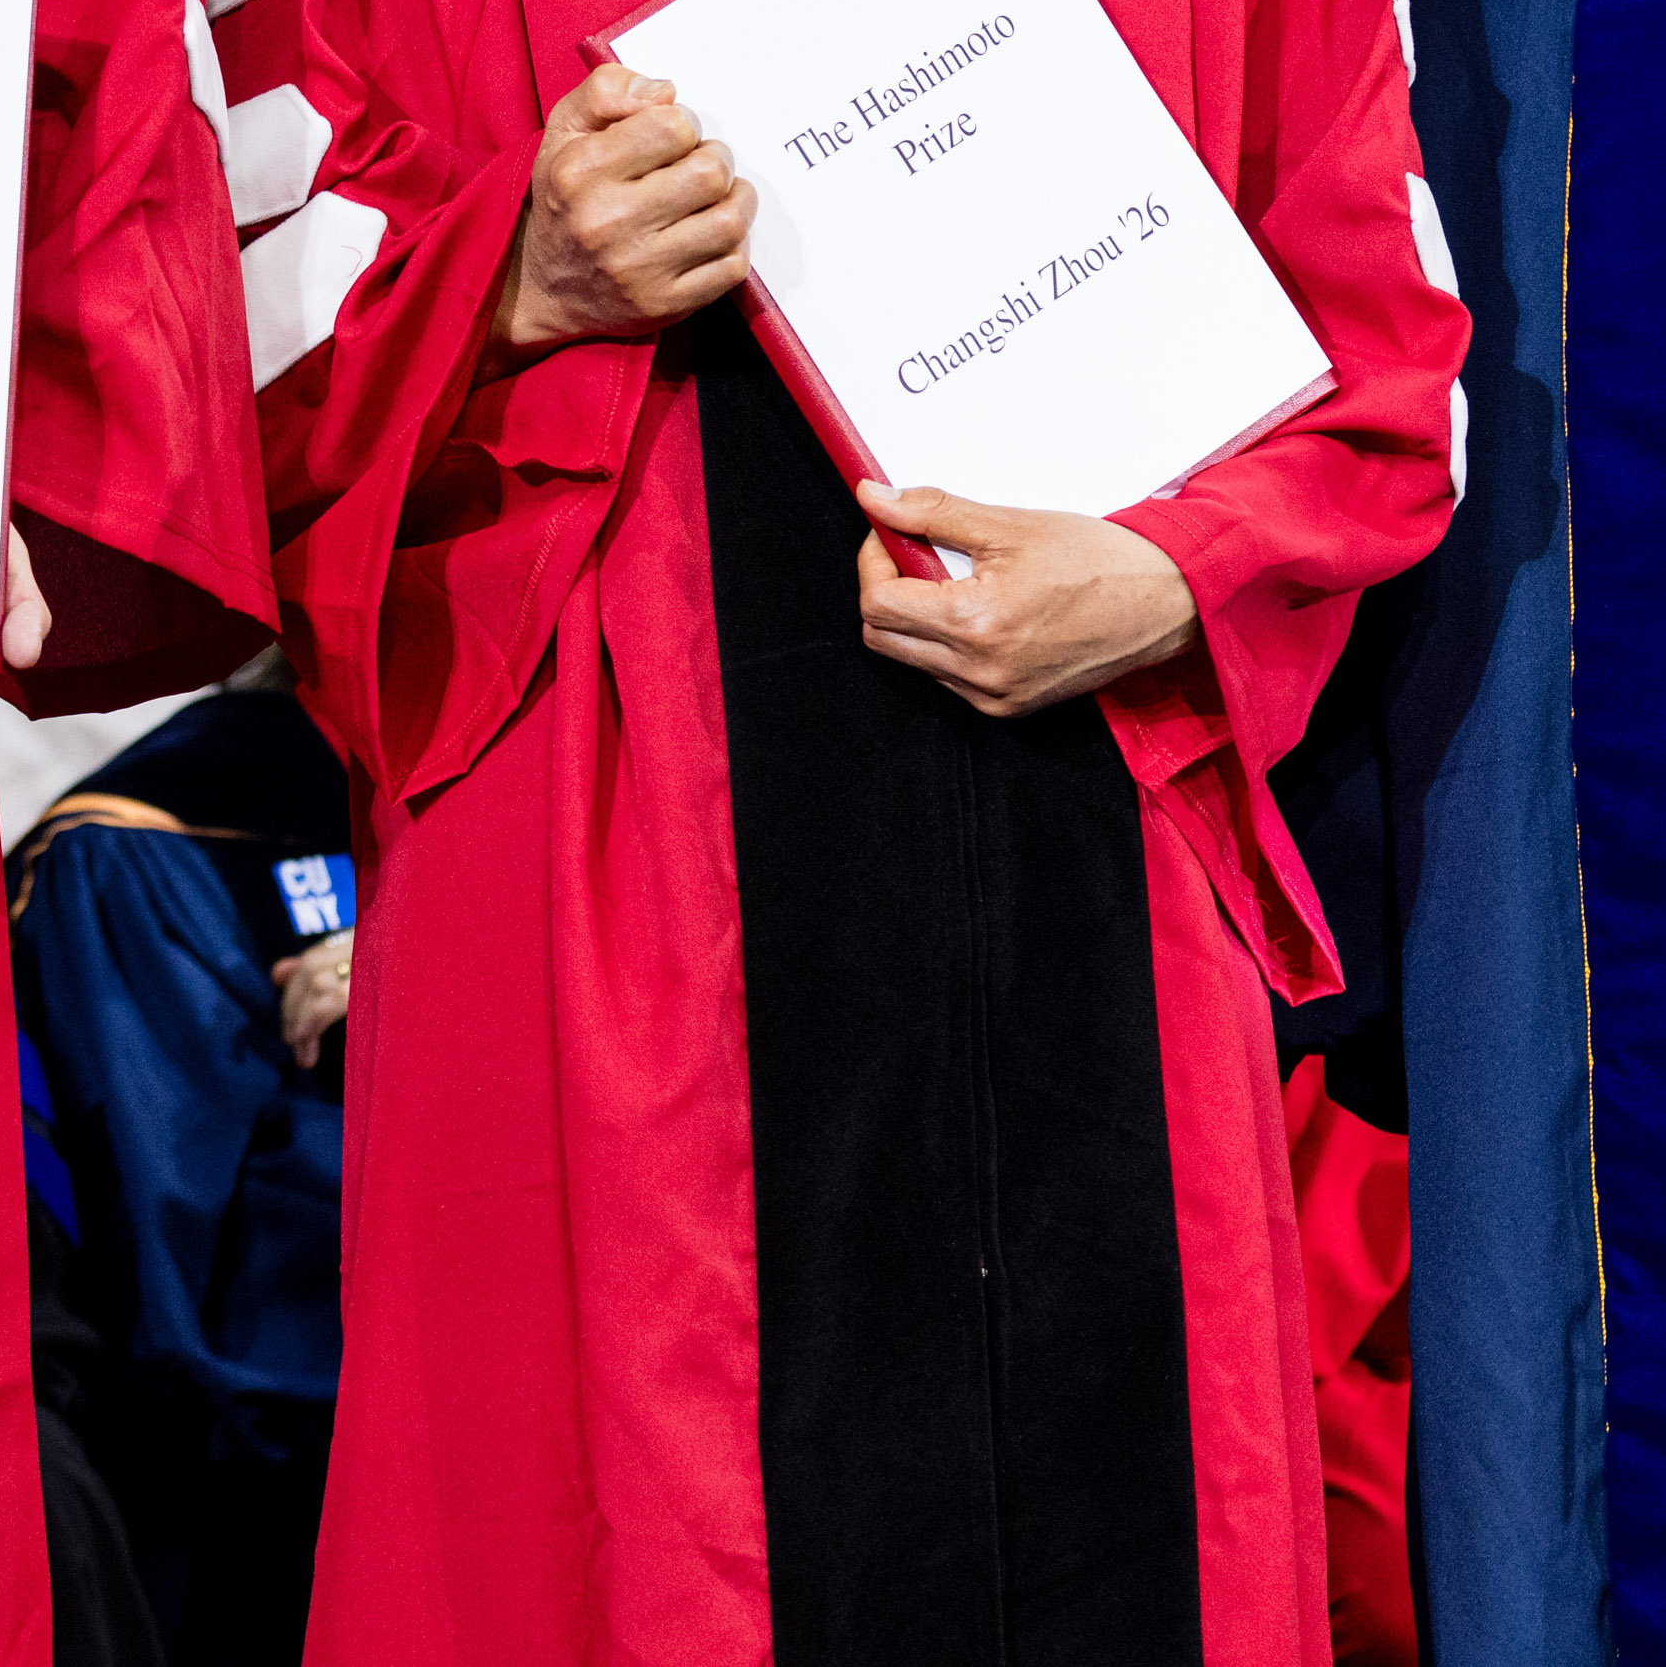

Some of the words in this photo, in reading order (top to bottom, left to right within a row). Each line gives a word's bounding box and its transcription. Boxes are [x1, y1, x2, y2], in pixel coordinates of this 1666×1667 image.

[784, 122, 853, 170] The
[851, 15, 1014, 130] Hashimoto
[892, 113, 977, 176] Prize
[898, 281, 1041, 394] Changshi
[1038, 236, 1124, 300] Zhou
[1118, 192, 1169, 241] '26
